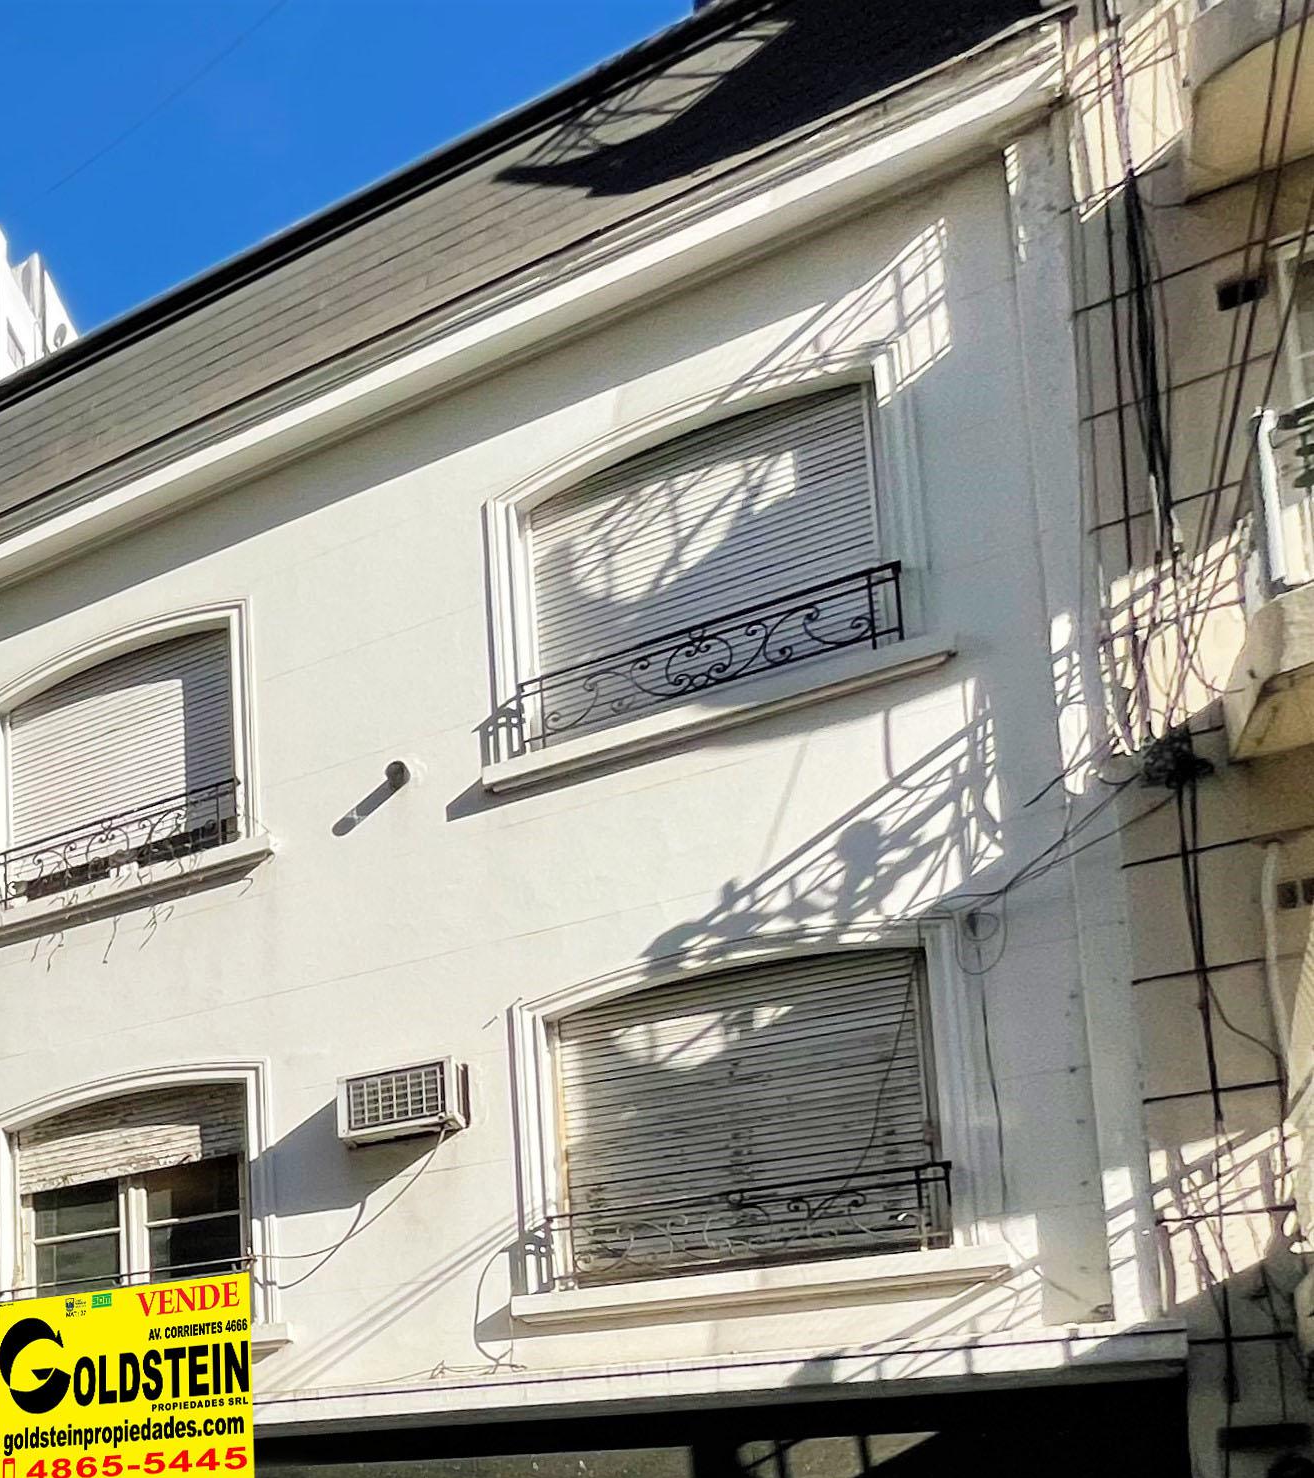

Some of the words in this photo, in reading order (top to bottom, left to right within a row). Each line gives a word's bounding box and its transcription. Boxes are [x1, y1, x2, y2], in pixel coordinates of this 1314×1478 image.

[137, 1281, 240, 1317] VENDE
[148, 1328, 162, 1341] AV.
[164, 1321, 223, 1339] CORRIENTES
[225, 1319, 248, 1333] 4666
[151, 1398, 225, 1412] PROPIEDADES
[228, 1397, 249, 1407] SRL
[3, 1416, 244, 1456] goldsteinpropiedades.com
